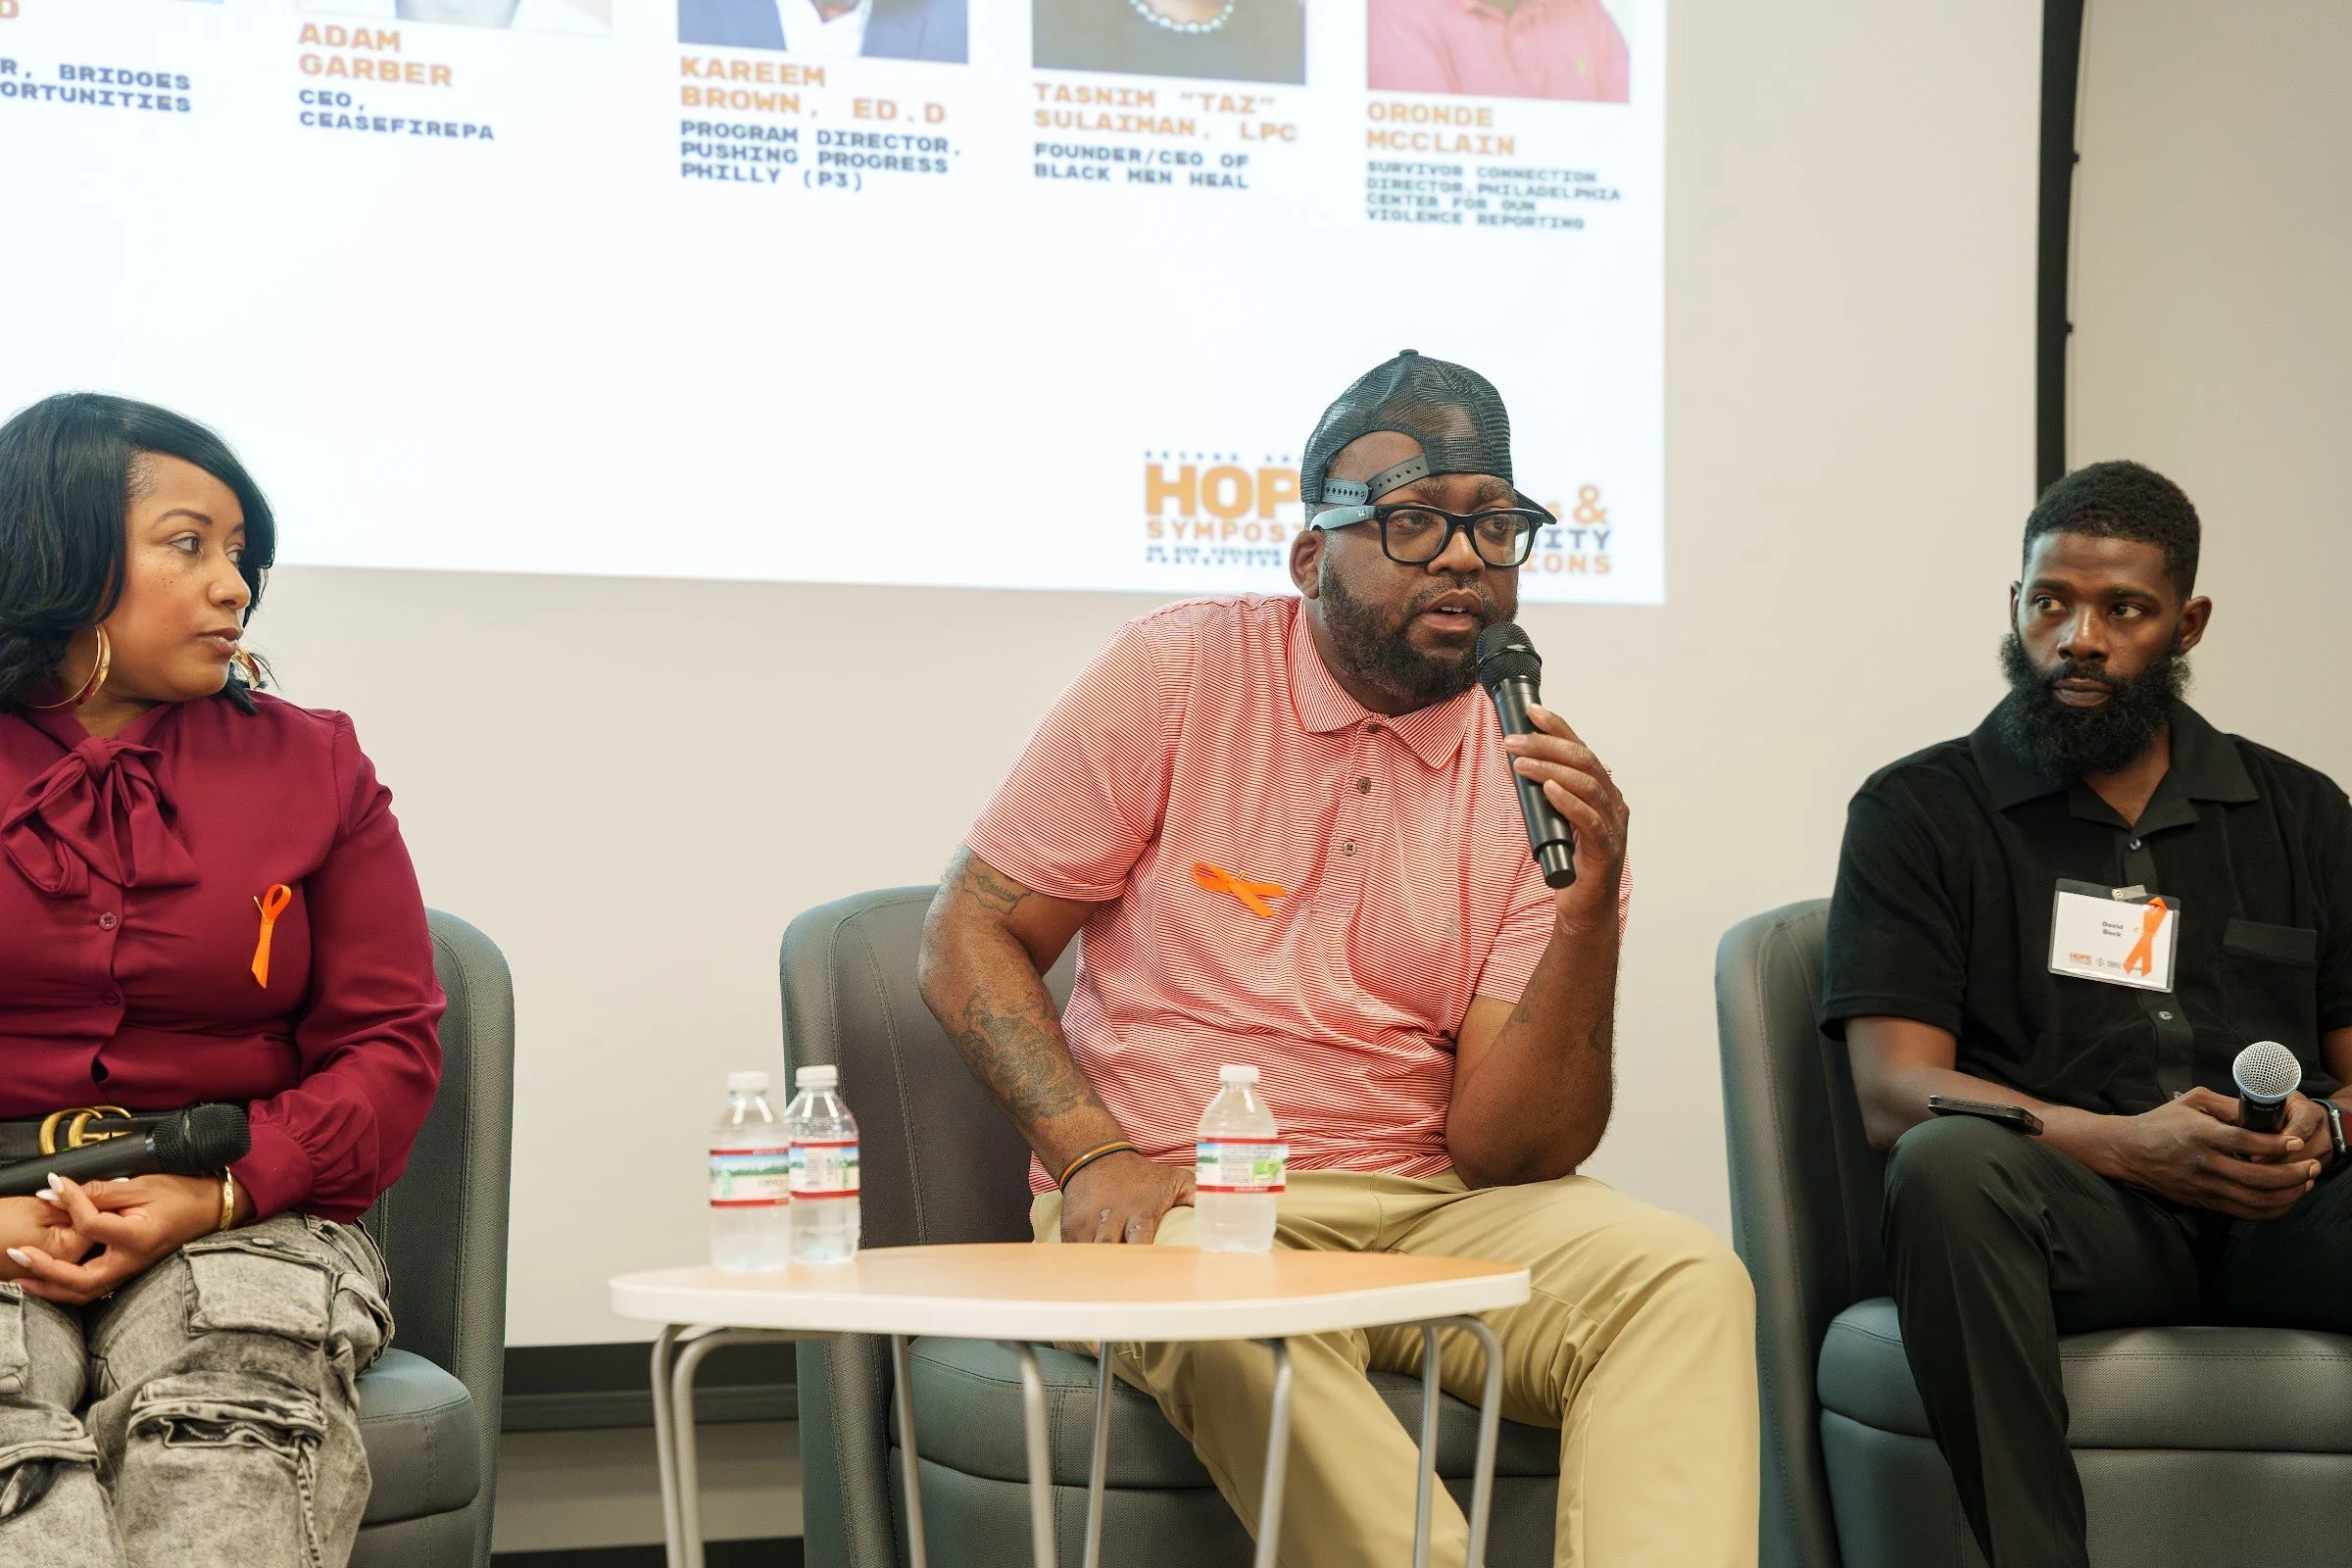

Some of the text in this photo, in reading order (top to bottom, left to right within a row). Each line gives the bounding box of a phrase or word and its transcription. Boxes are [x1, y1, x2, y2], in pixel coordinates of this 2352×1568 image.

[299, 23, 401, 52] ADAM
[299, 53, 453, 87] GARBER
[680, 56, 825, 86] KAREEM
[0, 81, 191, 112] ORTUNITIES
[299, 89, 364, 111] CEO,
[1034, 82, 1155, 108] TASNIM
[854, 97, 946, 123] ED.D
[1367, 102, 1494, 127] ORONDE
[300, 112, 494, 140] CEASEFIREPA
[681, 120, 798, 143] PROGRAM
[1241, 122, 1297, 142] LPC
[1034, 142, 1250, 169] FOUNDER/CEO OF
[1366, 129, 1515, 156] MCCLAIN
[681, 141, 949, 173] PUSHING PROGRESS
[681, 162, 862, 191] PHILLY (P3)
[1034, 163, 1250, 189] BLACK MEN HEAL
[1367, 161, 1596, 182] SURVIVOR CONNECTION
[1367, 194, 1439, 208] CENTER
[1453, 196, 1487, 210] FOR
[1478, 182, 1621, 201] PHILADELPHIA
[1367, 209, 1585, 229] VIOLENCE REPORTING
[1146, 464, 1301, 519] HOP
[1573, 485, 1607, 524] &
[1147, 520, 1304, 544] SYMPOS
[1536, 529, 1611, 550] ITY
